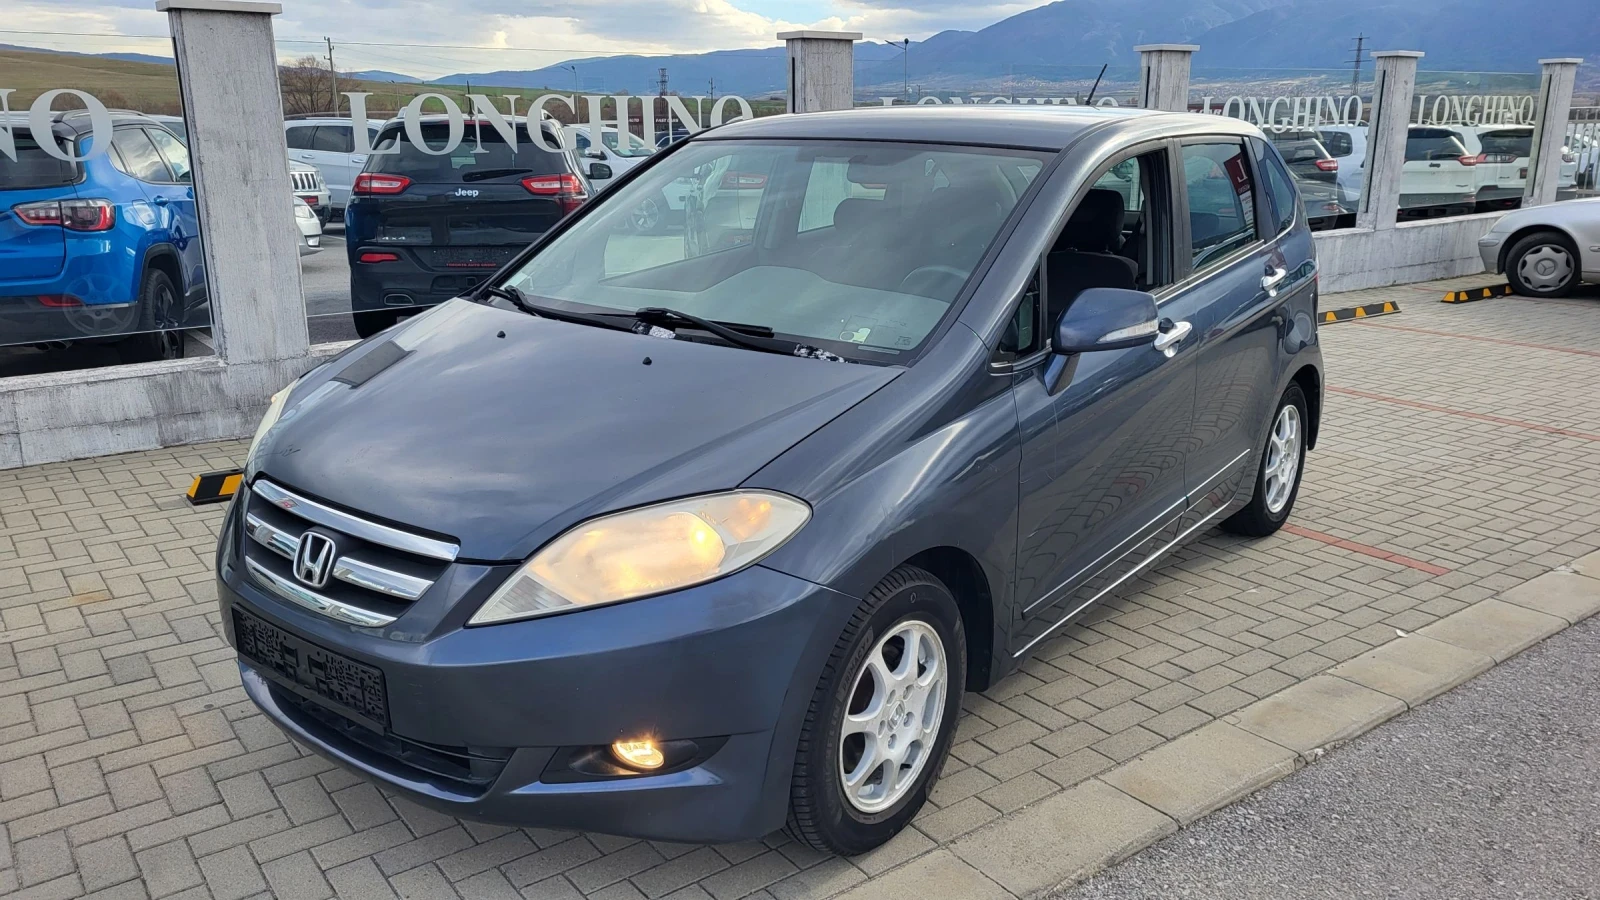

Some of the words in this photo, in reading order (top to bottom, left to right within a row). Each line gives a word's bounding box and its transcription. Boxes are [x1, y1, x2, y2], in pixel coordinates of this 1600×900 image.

[0, 89, 113, 163] O
[341, 92, 753, 156] LONGHINO
[1417, 95, 1534, 126] LONGHINO
[455, 188, 479, 198] Jeep
